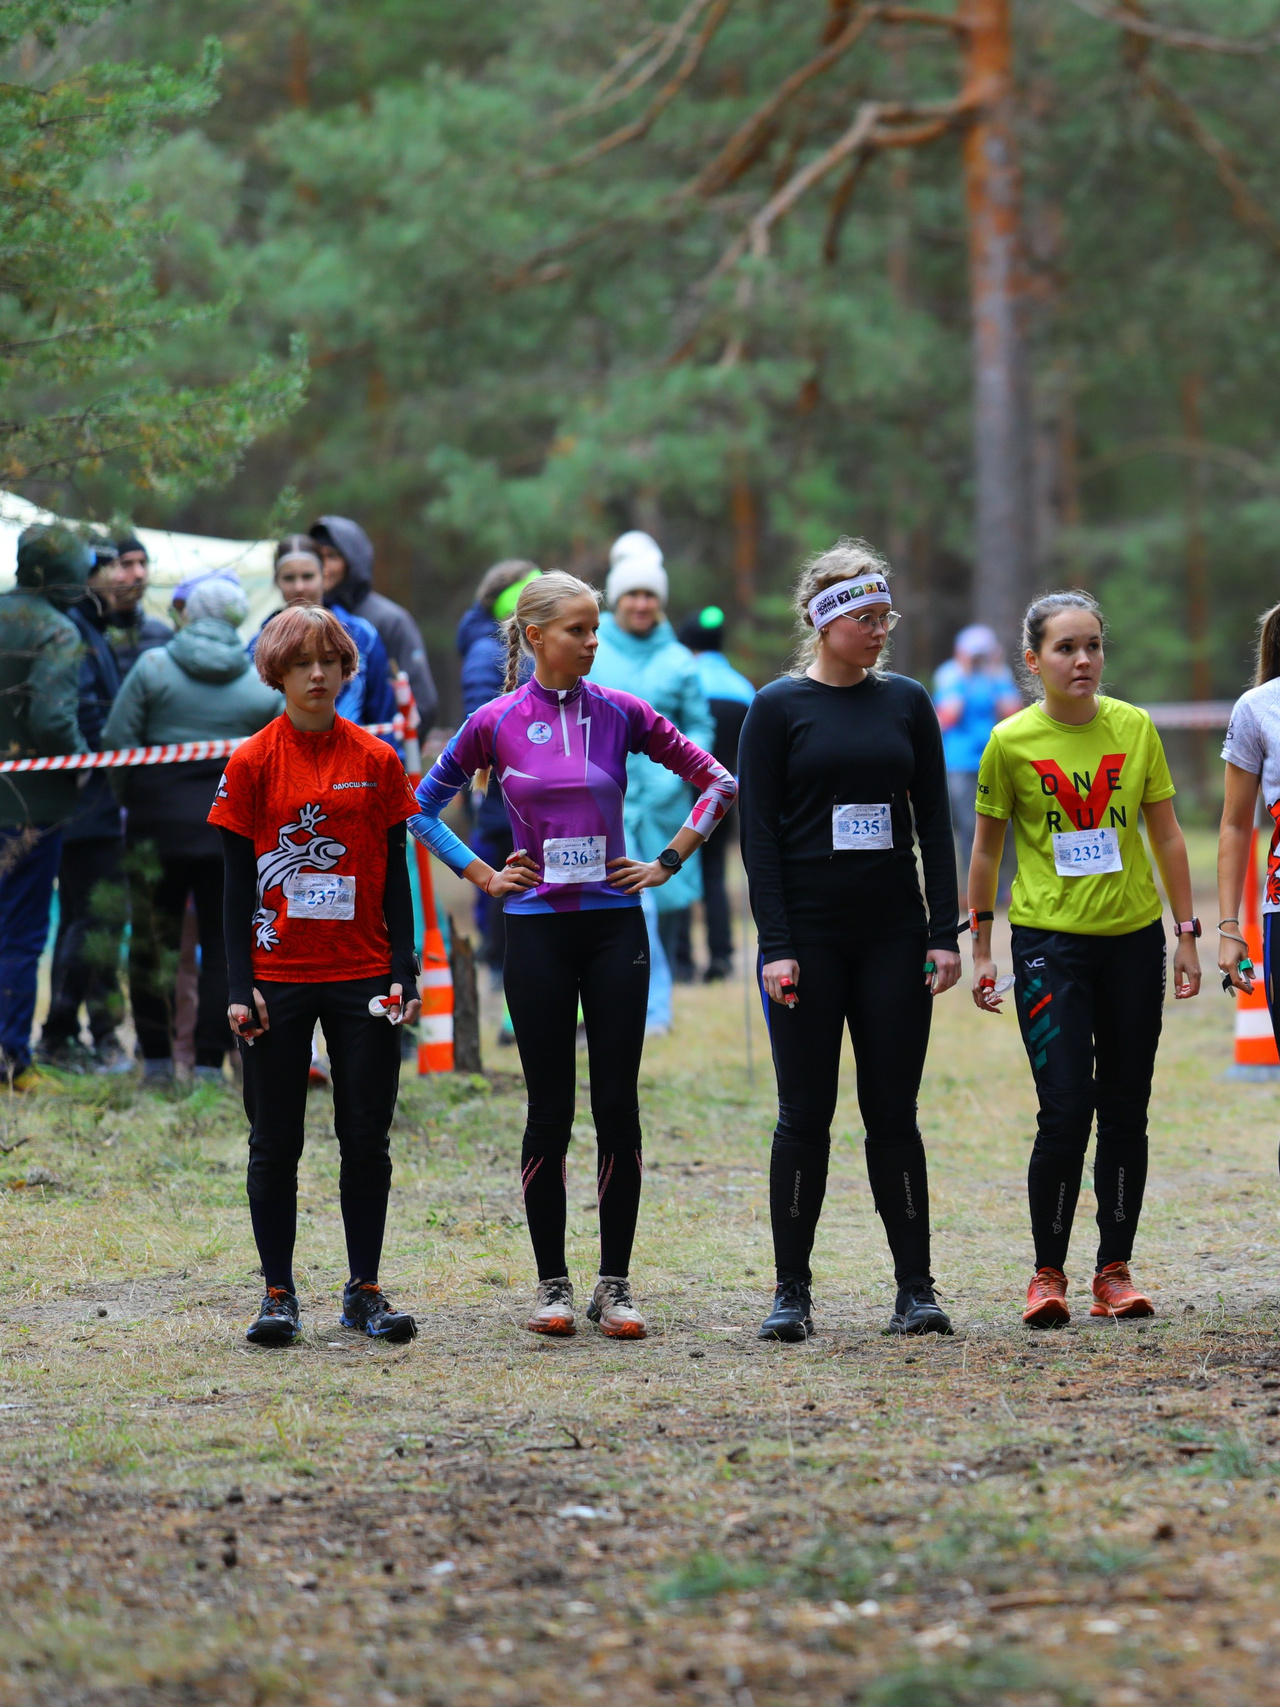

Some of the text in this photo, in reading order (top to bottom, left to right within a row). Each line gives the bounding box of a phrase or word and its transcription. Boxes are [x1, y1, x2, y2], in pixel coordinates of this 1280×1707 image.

[1041, 768, 1122, 796] ONE
[1046, 805, 1127, 833] RUN
[852, 820, 880, 835] 235
[561, 850, 588, 866] 236
[1073, 845, 1101, 862] 232
[307, 890, 337, 905] 237
